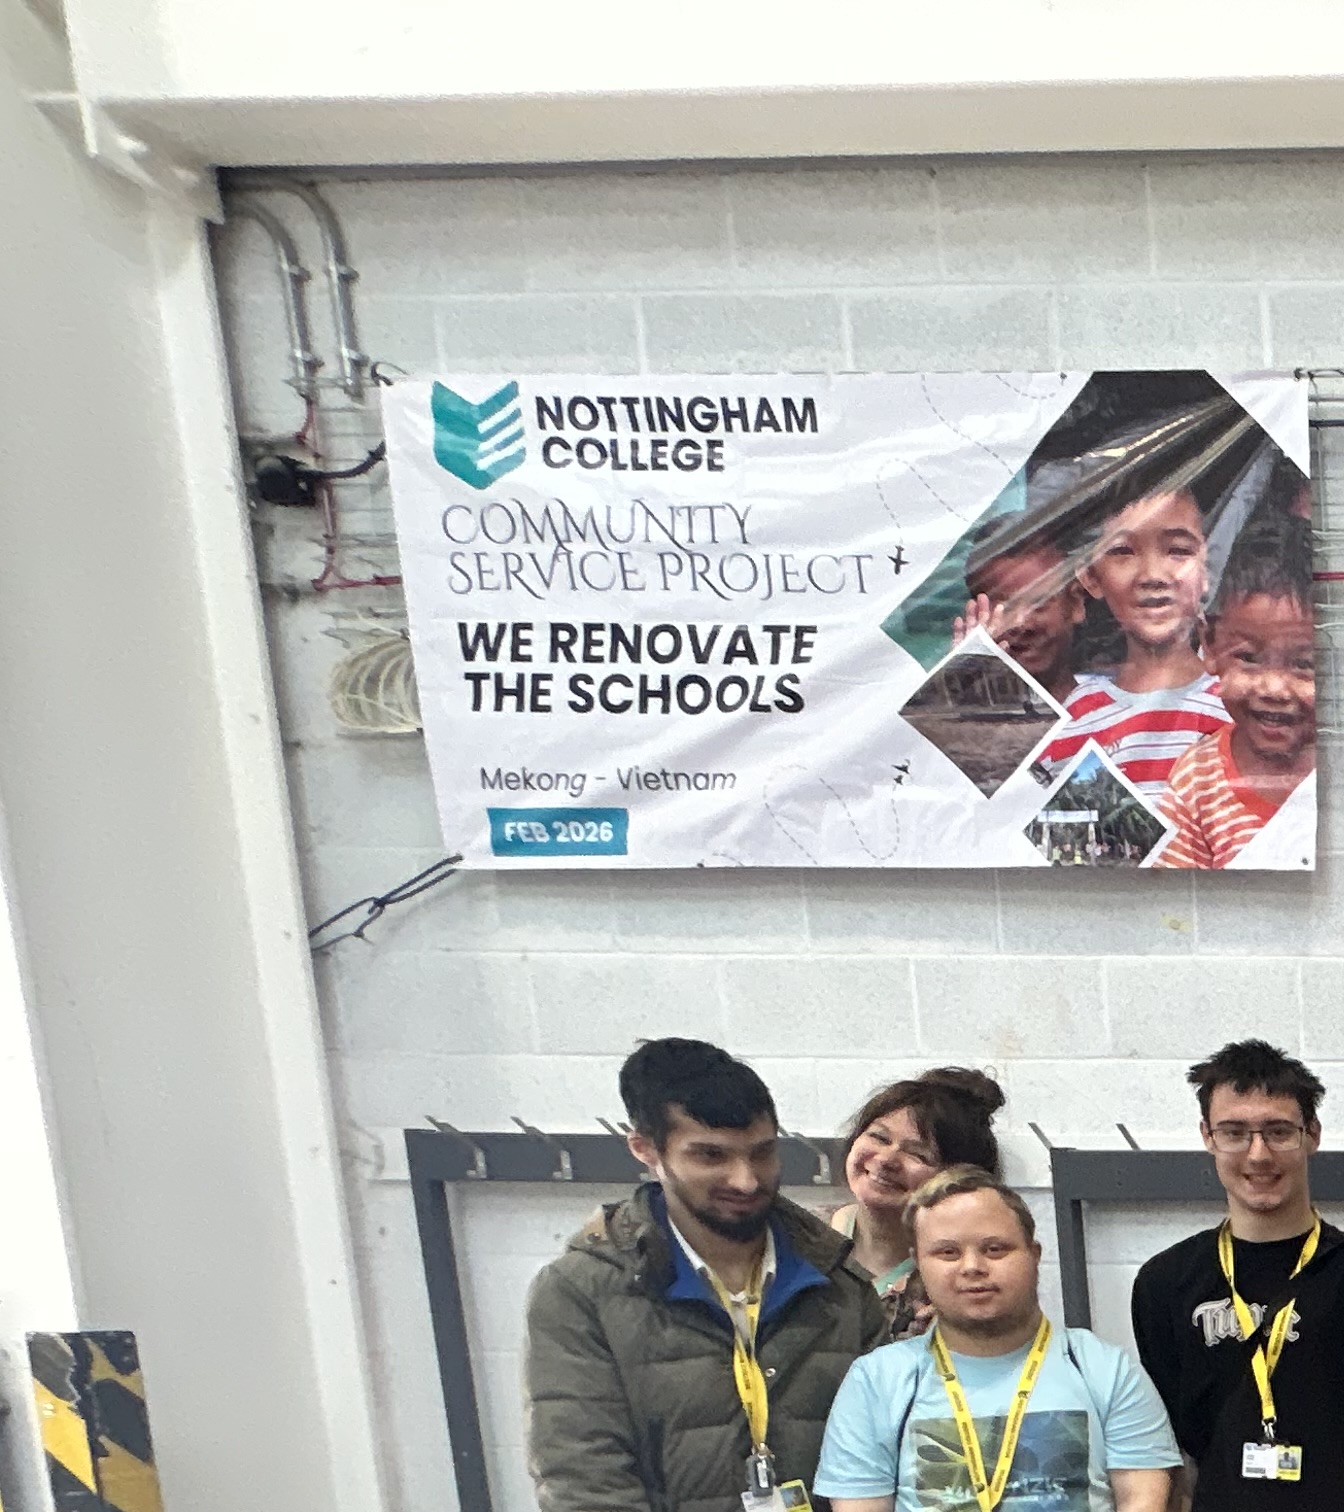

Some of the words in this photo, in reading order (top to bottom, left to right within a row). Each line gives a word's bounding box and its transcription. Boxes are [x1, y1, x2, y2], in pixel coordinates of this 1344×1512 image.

[534, 395, 819, 434] NOTTINGHAM
[541, 437, 726, 473] COLLEGE
[441, 497, 752, 551] COMMUNITY
[446, 543, 647, 600] SERVICE
[657, 551, 874, 601] PROJECT
[457, 621, 534, 664] WE
[547, 622, 819, 666] RENOVATE
[464, 672, 554, 713] THE
[567, 672, 806, 716] SCHOOLS
[480, 765, 588, 798] Mekong
[615, 764, 738, 792] Vietnam
[504, 821, 549, 844] FEB
[553, 820, 614, 843] 2026
